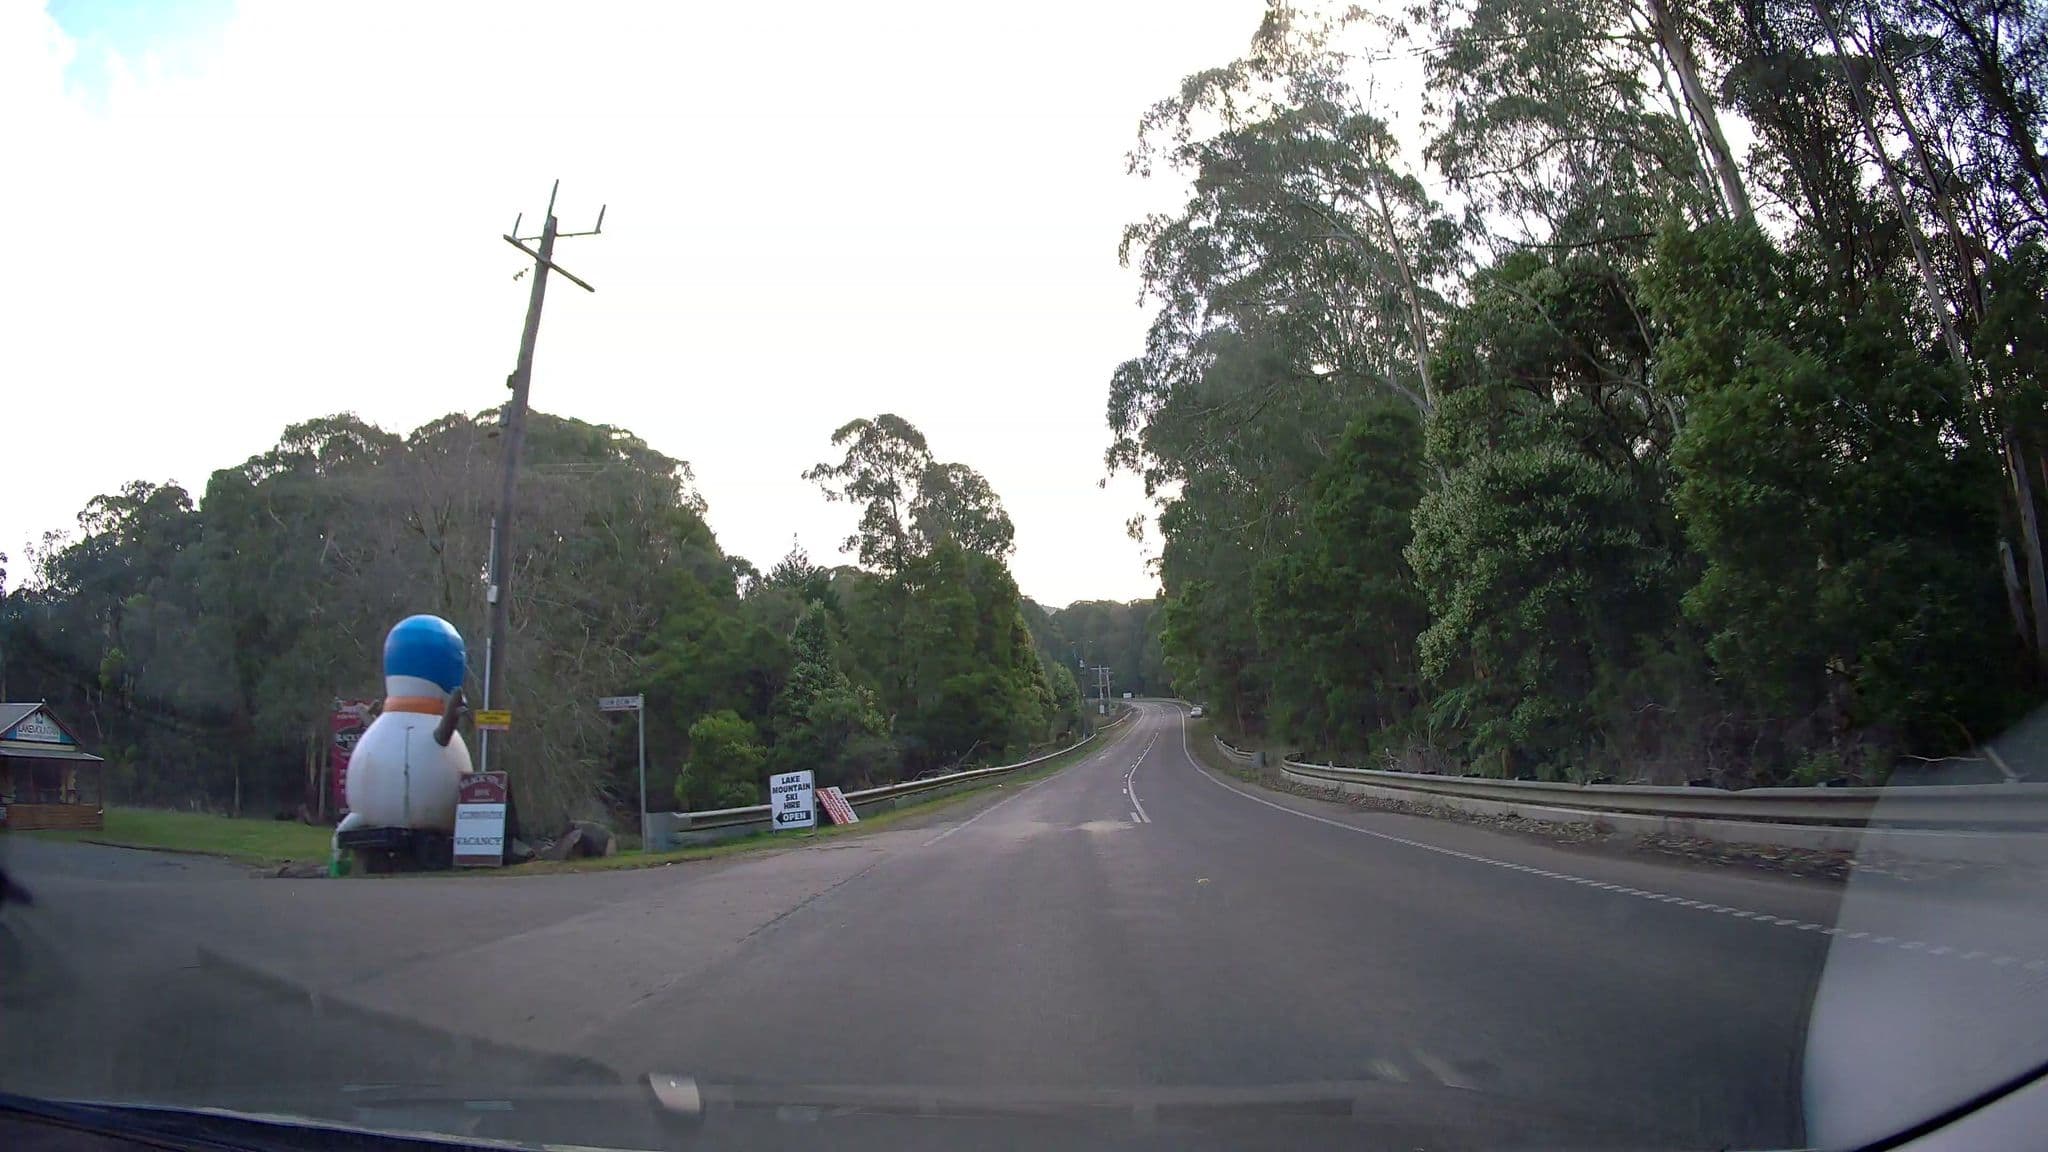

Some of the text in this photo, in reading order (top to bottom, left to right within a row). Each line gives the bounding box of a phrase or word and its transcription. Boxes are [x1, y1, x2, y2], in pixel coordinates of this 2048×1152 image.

[782, 776, 800, 784] LAKE
[772, 784, 810, 793] MOUNTAIN
[785, 793, 798, 801] SKI
[784, 801, 800, 809] HIRE
[782, 812, 806, 821] OPEN
[456, 836, 503, 846] VACANCY
